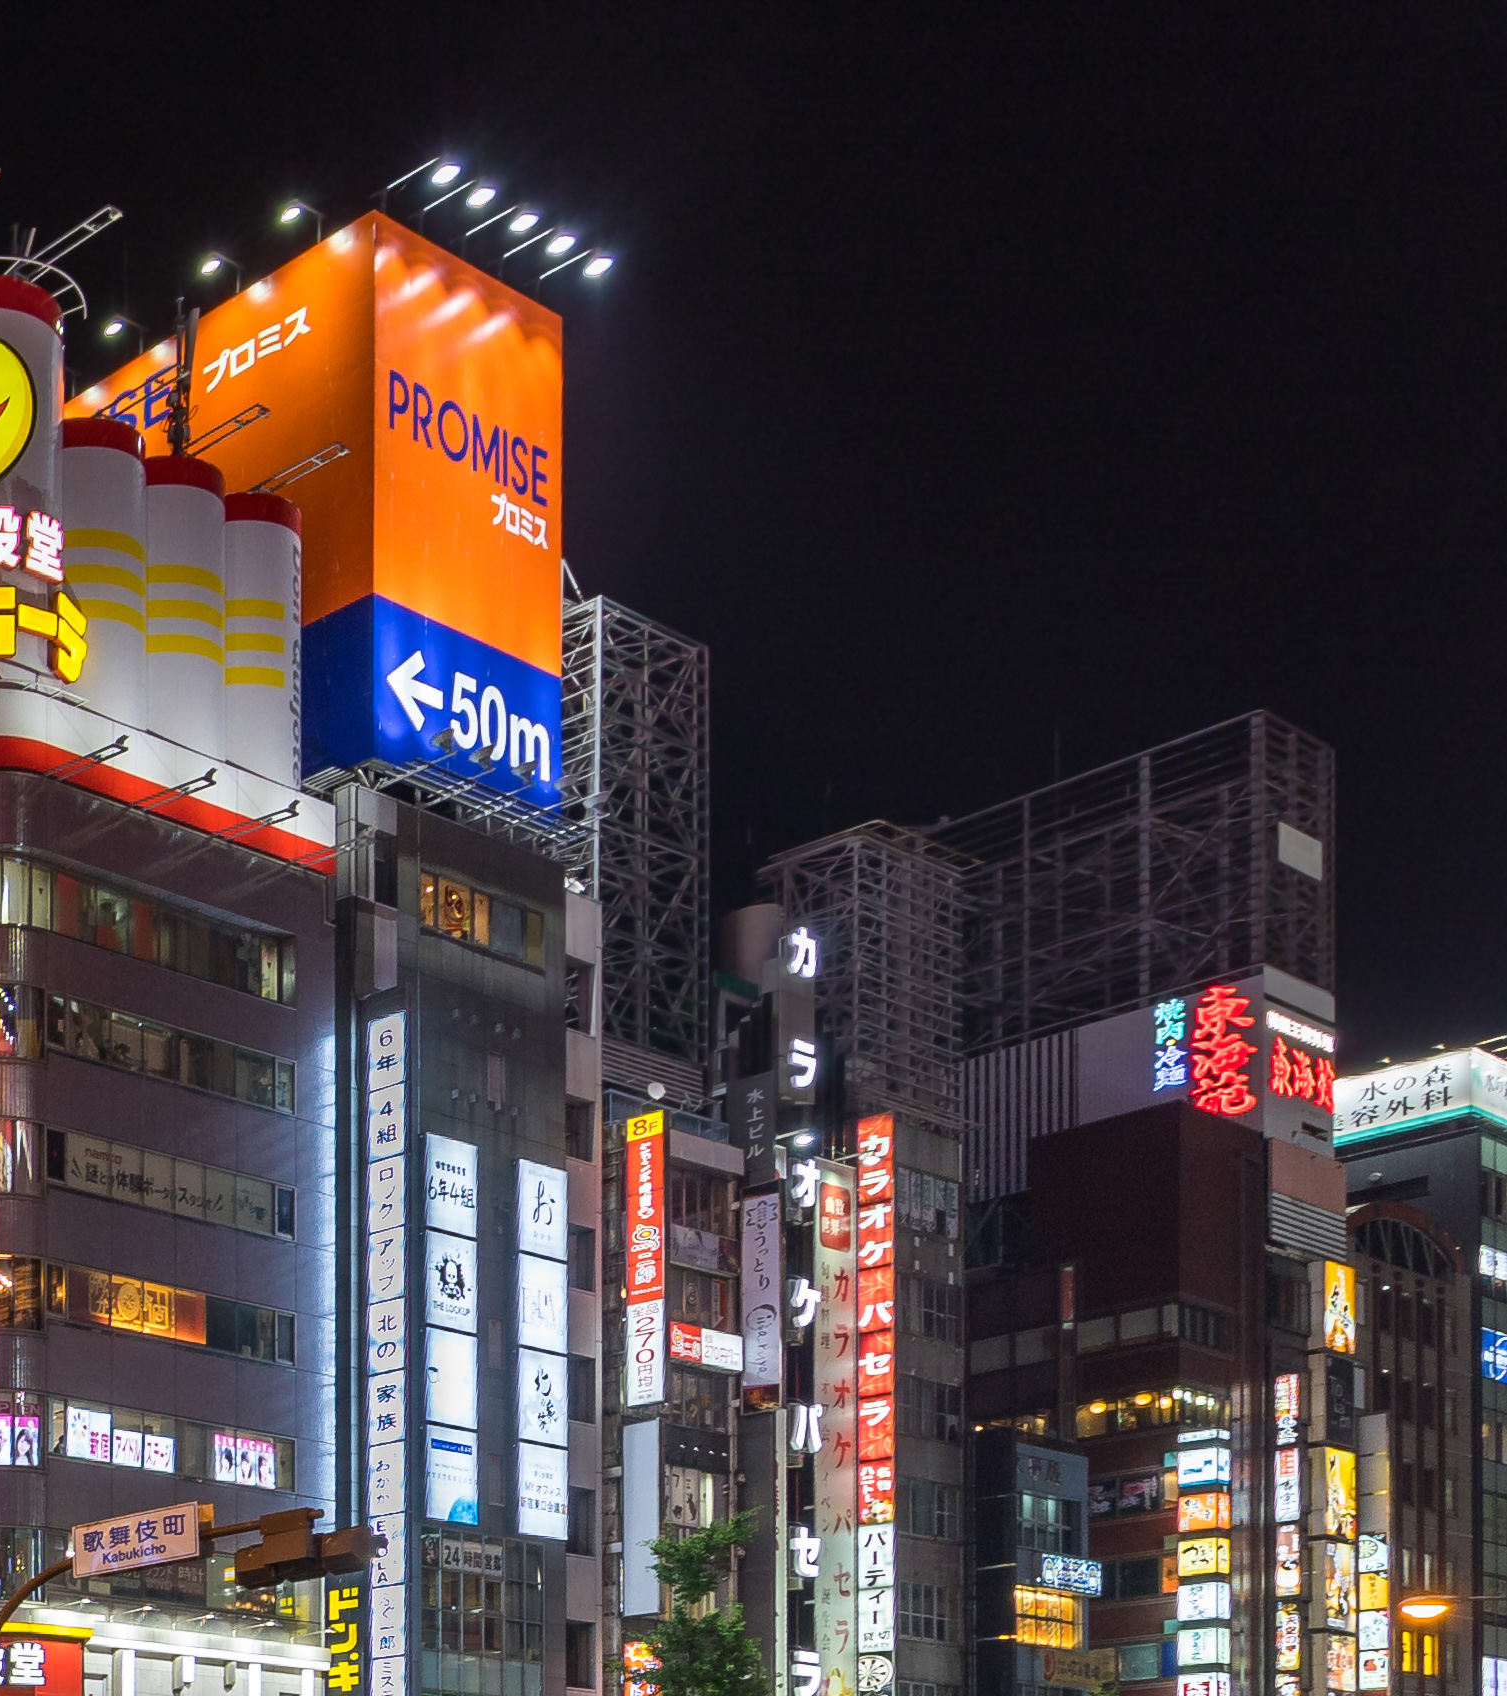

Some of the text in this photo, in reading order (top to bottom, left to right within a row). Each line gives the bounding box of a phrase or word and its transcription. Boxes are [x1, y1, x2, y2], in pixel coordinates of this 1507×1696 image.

[202, 306, 312, 394] プロミス
[388, 369, 549, 509] PROMISE
[450, 668, 551, 784] 50m
[1359, 1065, 1453, 1102] 水の森
[631, 1119, 659, 1137] 8F
[745, 1088, 766, 1160] 水上ビル
[427, 1177, 476, 1209] 6年4組
[377, 1167, 396, 1292] ロックアップ
[82, 1514, 185, 1554] 歌舞伎町
[101, 1542, 167, 1566] Kabukicho
[443, 1543, 504, 1571] 24時間営業
[864, 1529, 887, 1624] パーティー
